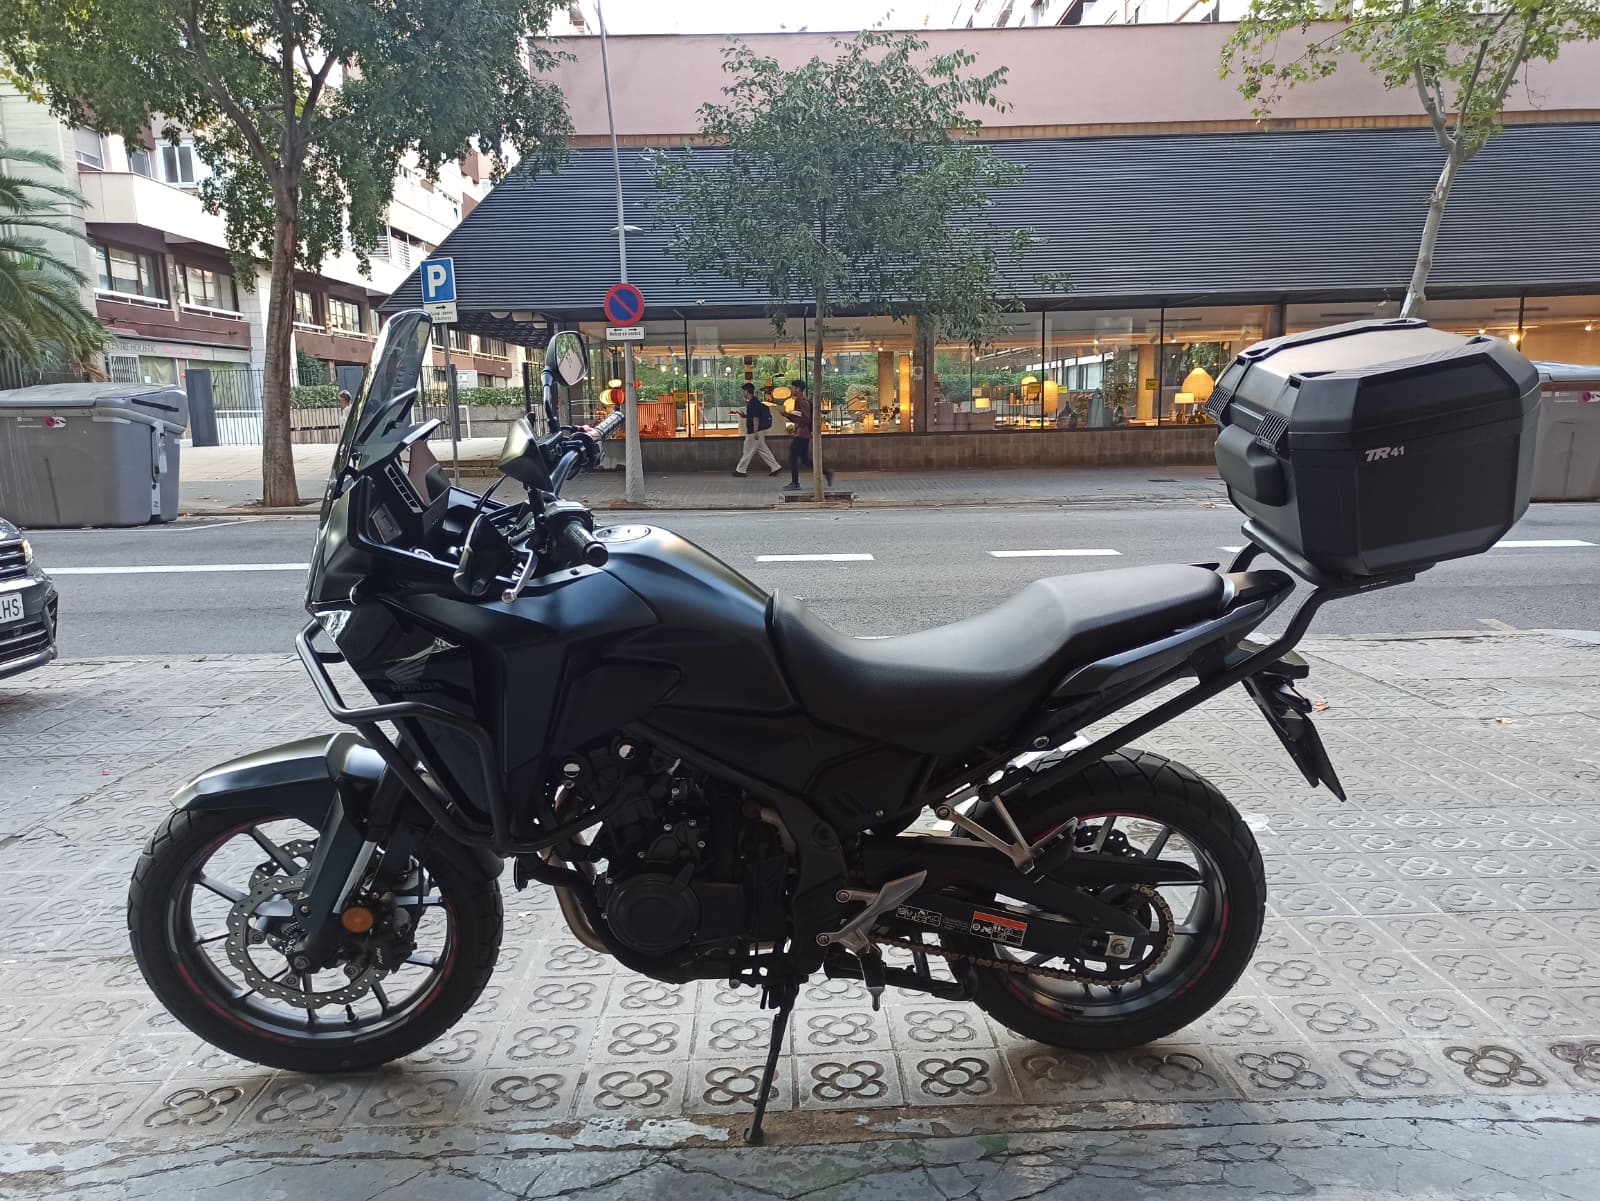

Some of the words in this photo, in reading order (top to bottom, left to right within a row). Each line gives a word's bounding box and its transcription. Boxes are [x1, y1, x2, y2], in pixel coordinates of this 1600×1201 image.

[427, 264, 447, 298] P
[0, 599, 20, 619] HS
[391, 681, 443, 692] HONDA
